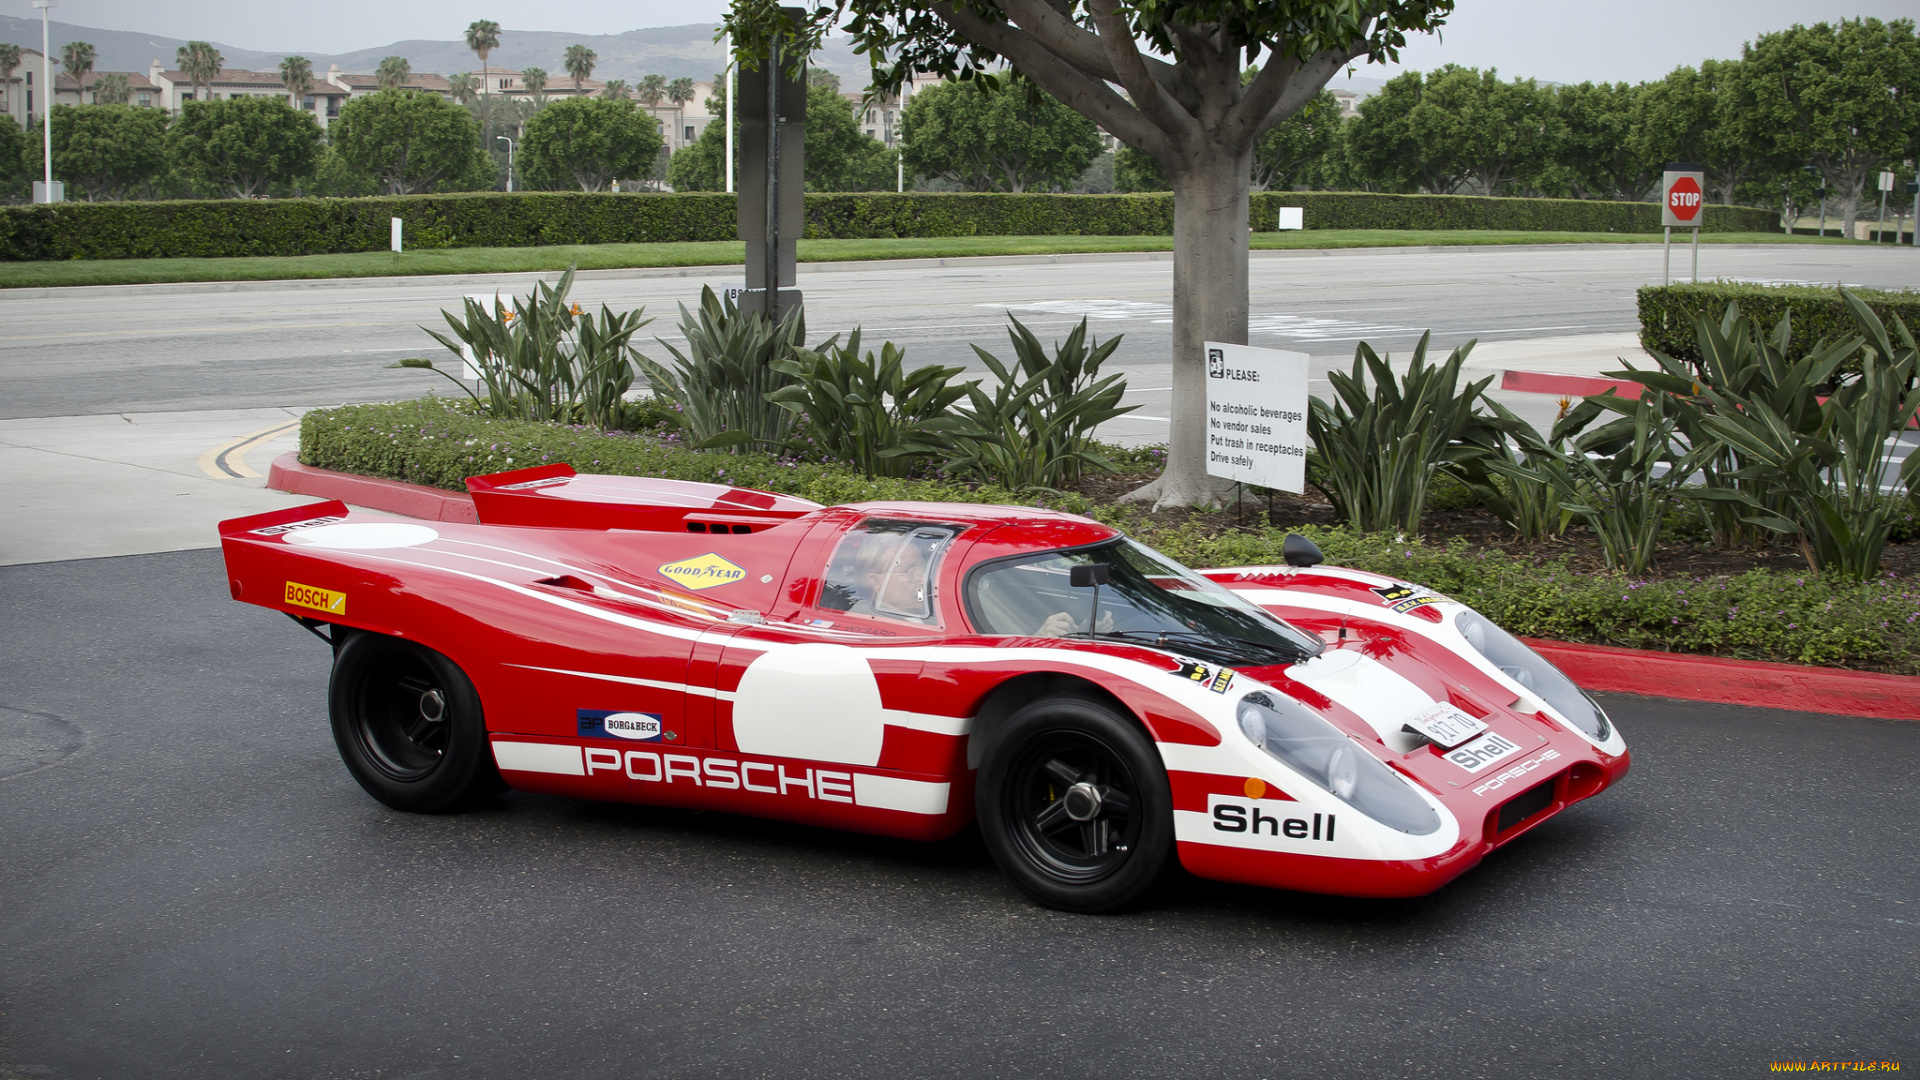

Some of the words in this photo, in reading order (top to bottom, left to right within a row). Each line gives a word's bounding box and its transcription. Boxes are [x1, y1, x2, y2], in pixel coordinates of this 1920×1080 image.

[1671, 192, 1700, 207] STOP
[1226, 368, 1260, 382] PLEASE:
[1210, 400, 1221, 411] No
[1222, 403, 1258, 417] alcoholic
[1260, 406, 1302, 423] beverages
[1210, 417, 1221, 429] No
[1222, 420, 1248, 432] vendor
[1250, 423, 1272, 435] sales
[1210, 434, 1223, 446] Put
[1224, 437, 1244, 449] trash
[1246, 439, 1254, 450] in
[1255, 442, 1304, 457] receptacles
[1210, 451, 1229, 464] Drive
[1231, 454, 1254, 470] safely
[256, 516, 341, 535] Shell
[286, 585, 329, 609] BOSCH
[608, 719, 658, 732] BORG&BECK
[1450, 735, 1516, 769] Shell
[584, 746, 854, 804] PORSCHE
[1472, 749, 1562, 797] PORSCHE
[1212, 803, 1336, 842] Shell
